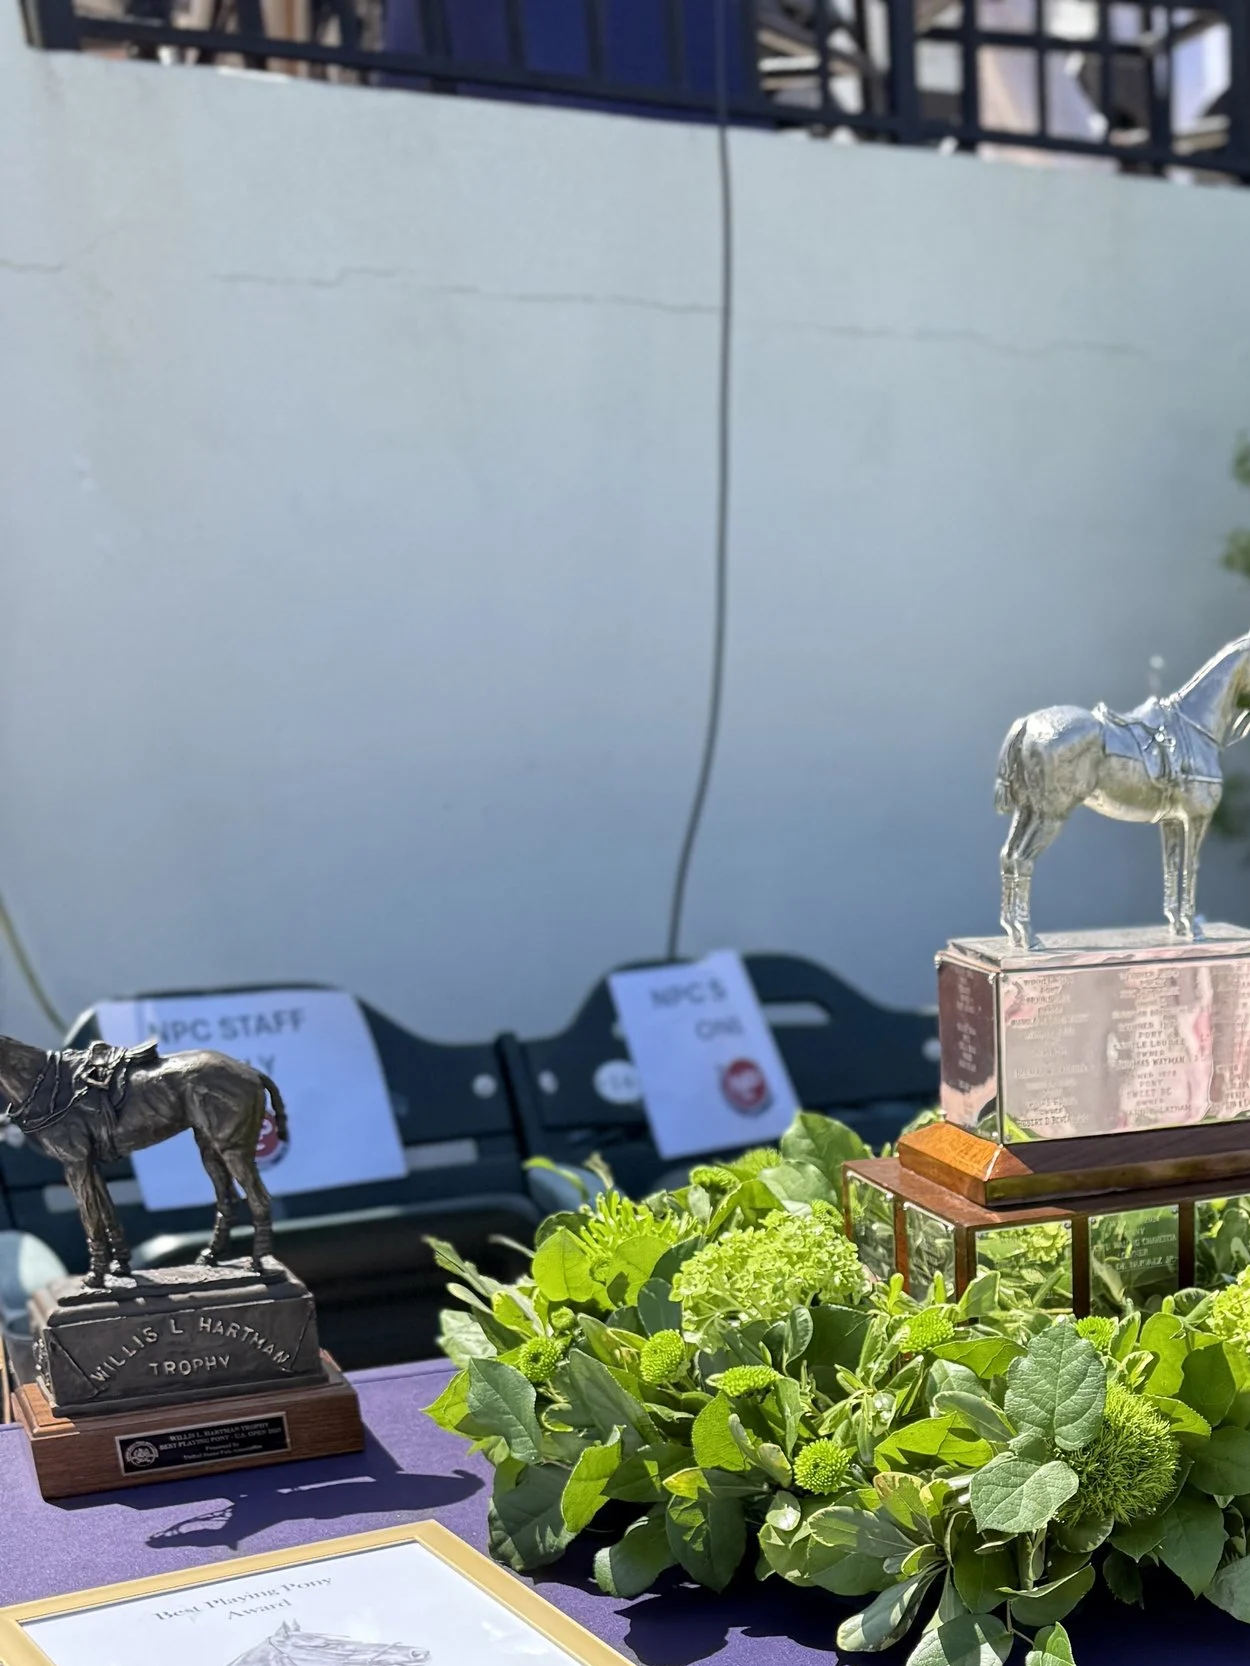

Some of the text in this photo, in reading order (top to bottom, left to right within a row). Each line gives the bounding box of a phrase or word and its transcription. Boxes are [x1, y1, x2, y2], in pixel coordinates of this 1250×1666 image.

[148, 1007, 305, 1045] NPC STAFF
[91, 1316, 291, 1383] WILLIS L HARTMAN
[149, 1355, 231, 1376] TROPHY
[154, 1577, 332, 1621] Best Playing Pony
[227, 1599, 293, 1620] Award
